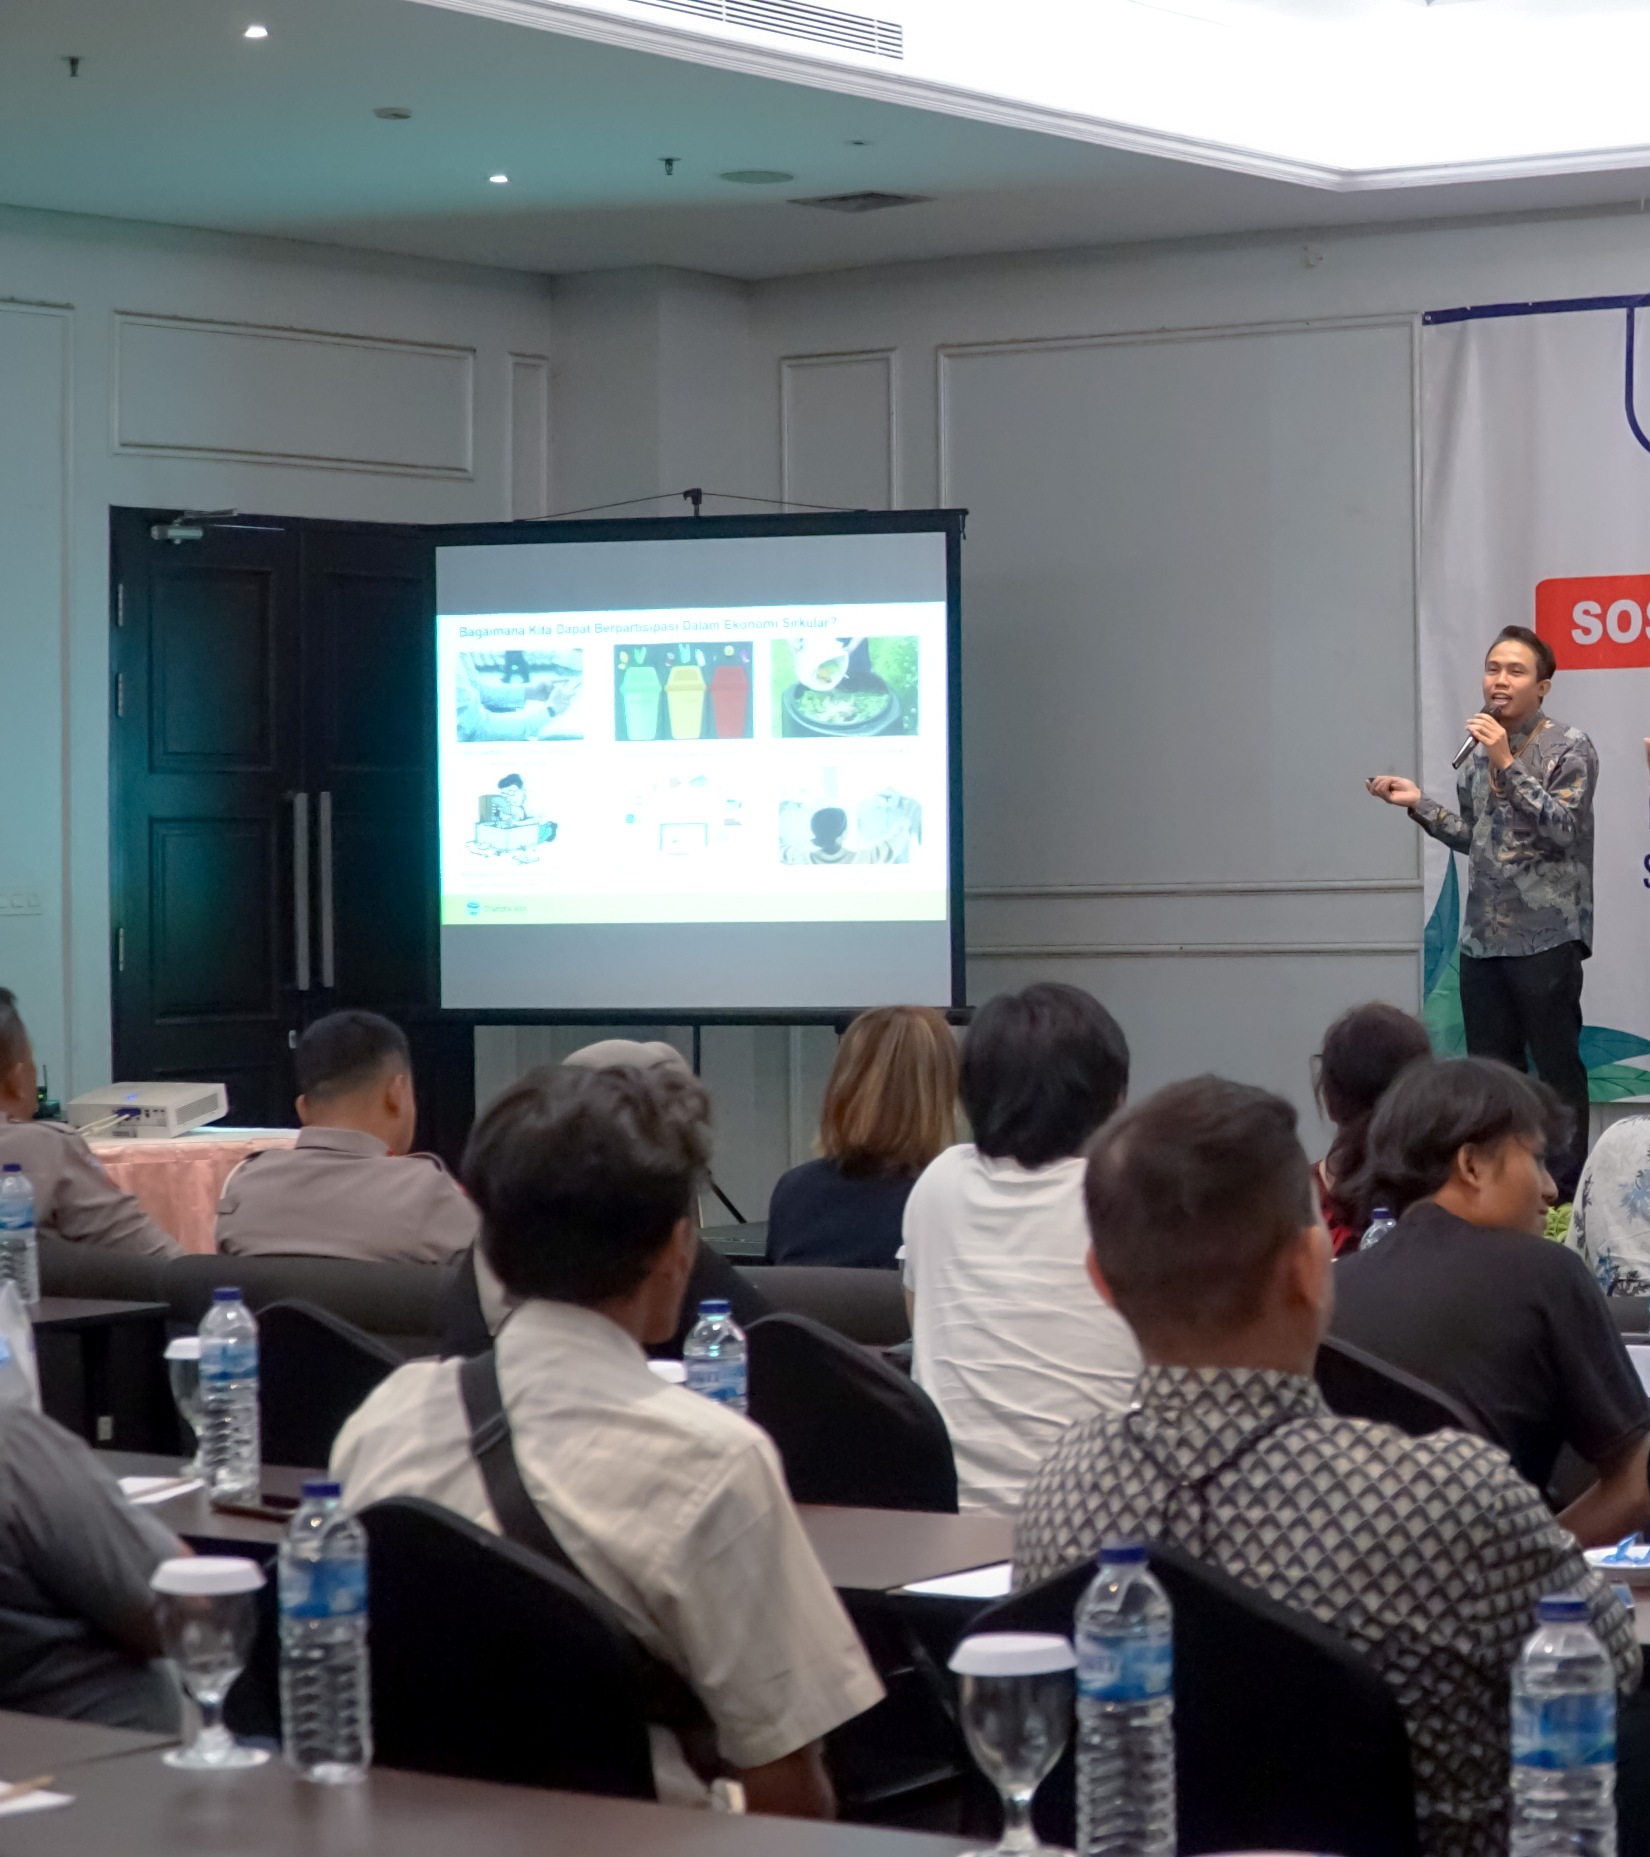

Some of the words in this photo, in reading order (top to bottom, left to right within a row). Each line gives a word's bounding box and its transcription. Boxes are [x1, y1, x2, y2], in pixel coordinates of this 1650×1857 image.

[459, 626, 525, 639] Bagaimana
[529, 624, 552, 635] Kita
[556, 623, 591, 635] Dapat
[594, 621, 679, 634] Berpartisipasi
[683, 620, 720, 631] Dalam
[724, 618, 778, 630] Ekonomi
